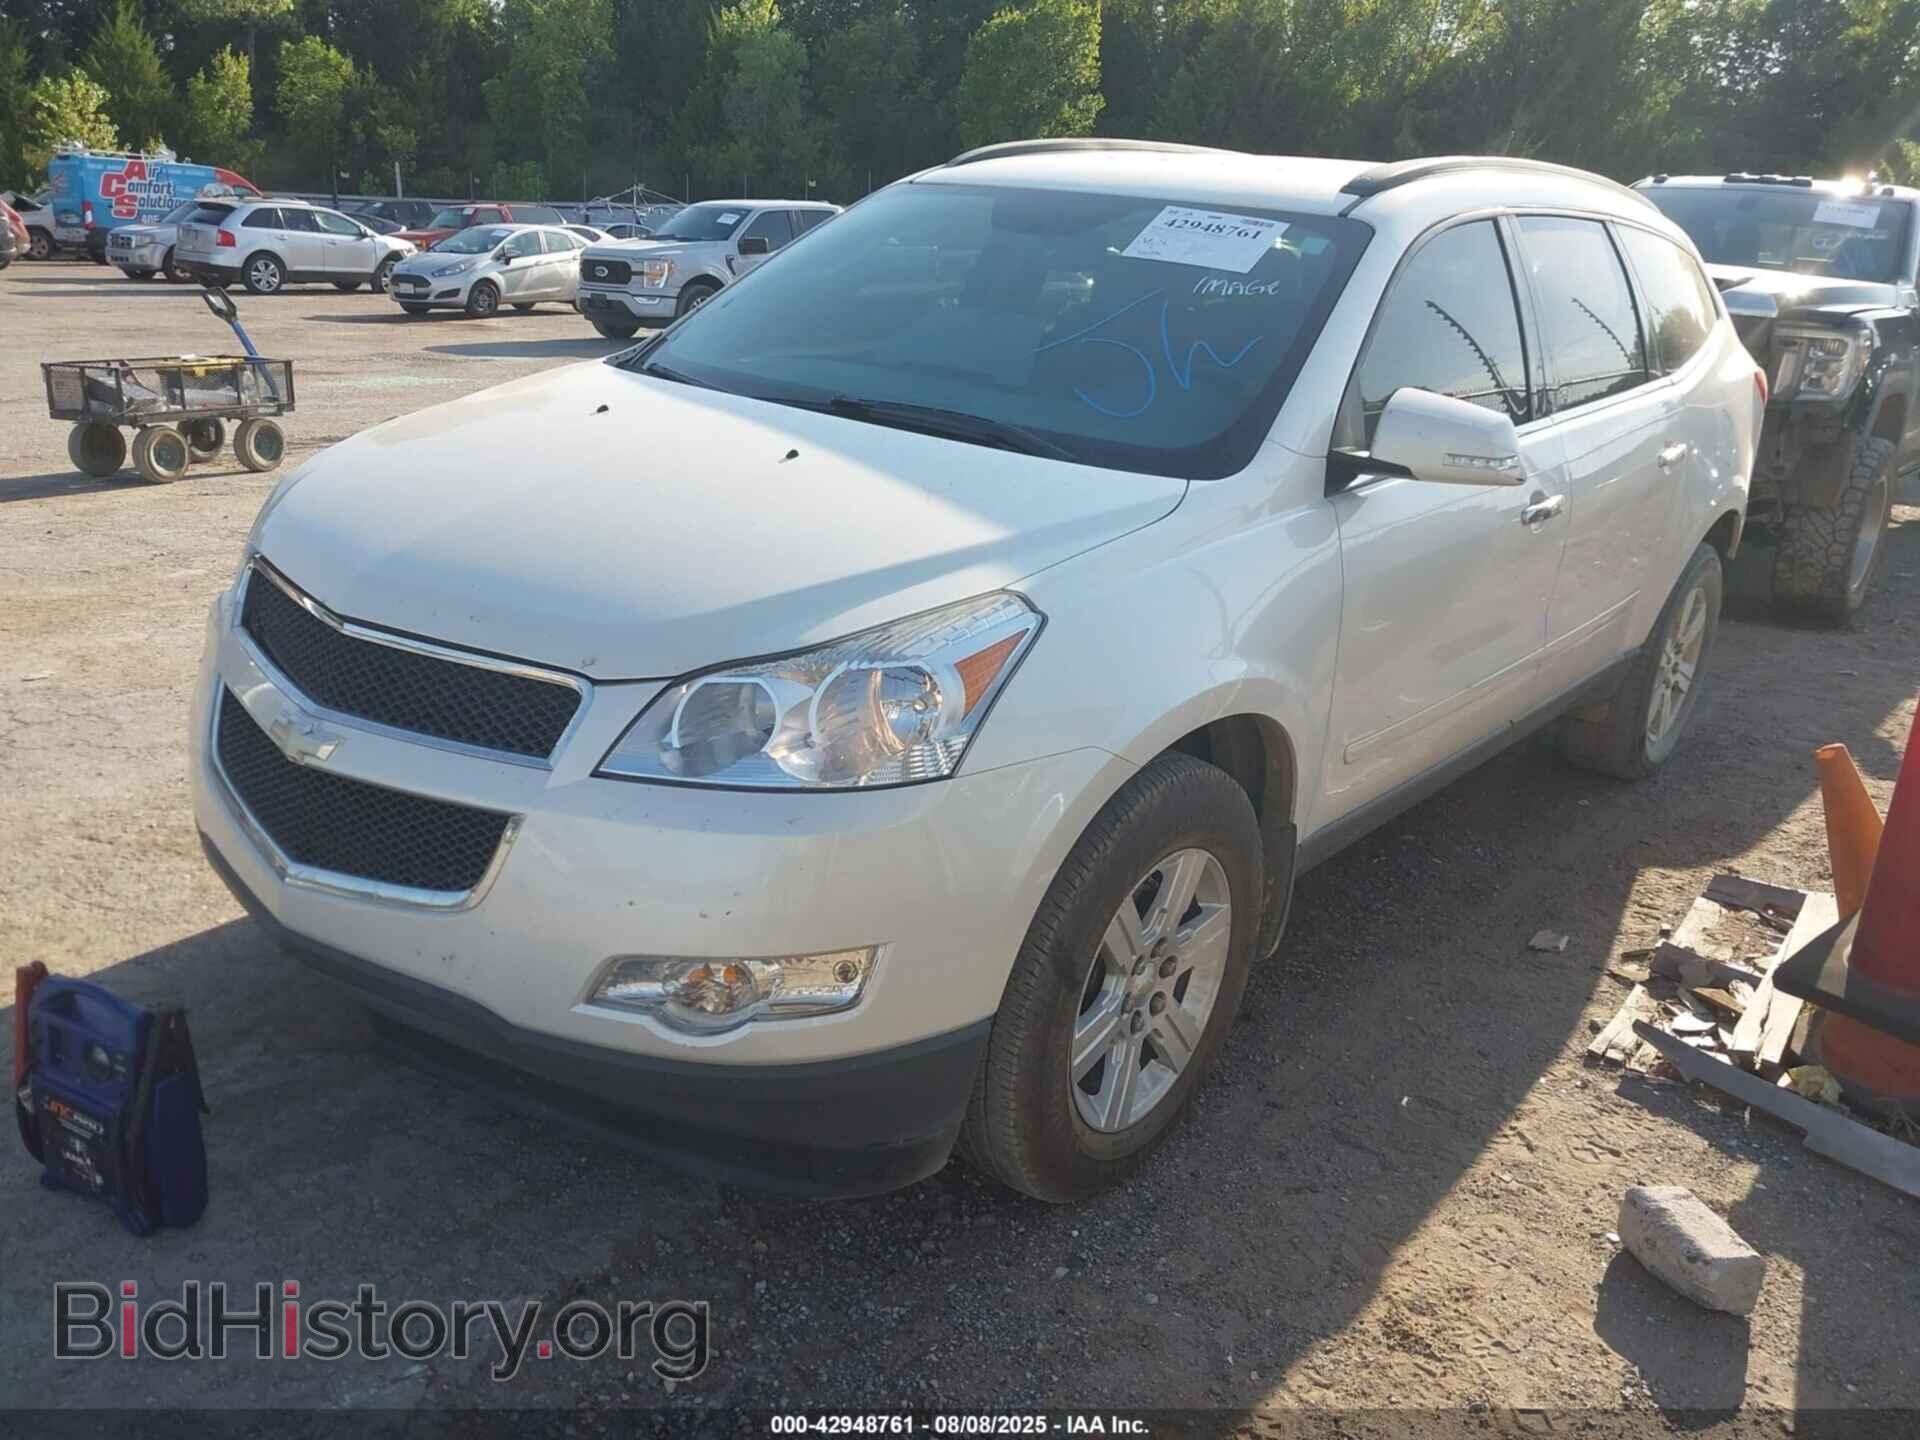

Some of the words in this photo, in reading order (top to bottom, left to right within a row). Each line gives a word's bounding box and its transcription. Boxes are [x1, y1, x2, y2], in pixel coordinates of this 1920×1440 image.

[123, 160, 161, 180] Air
[99, 172, 173, 199] Comfort
[1164, 217, 1263, 241] 42948761
